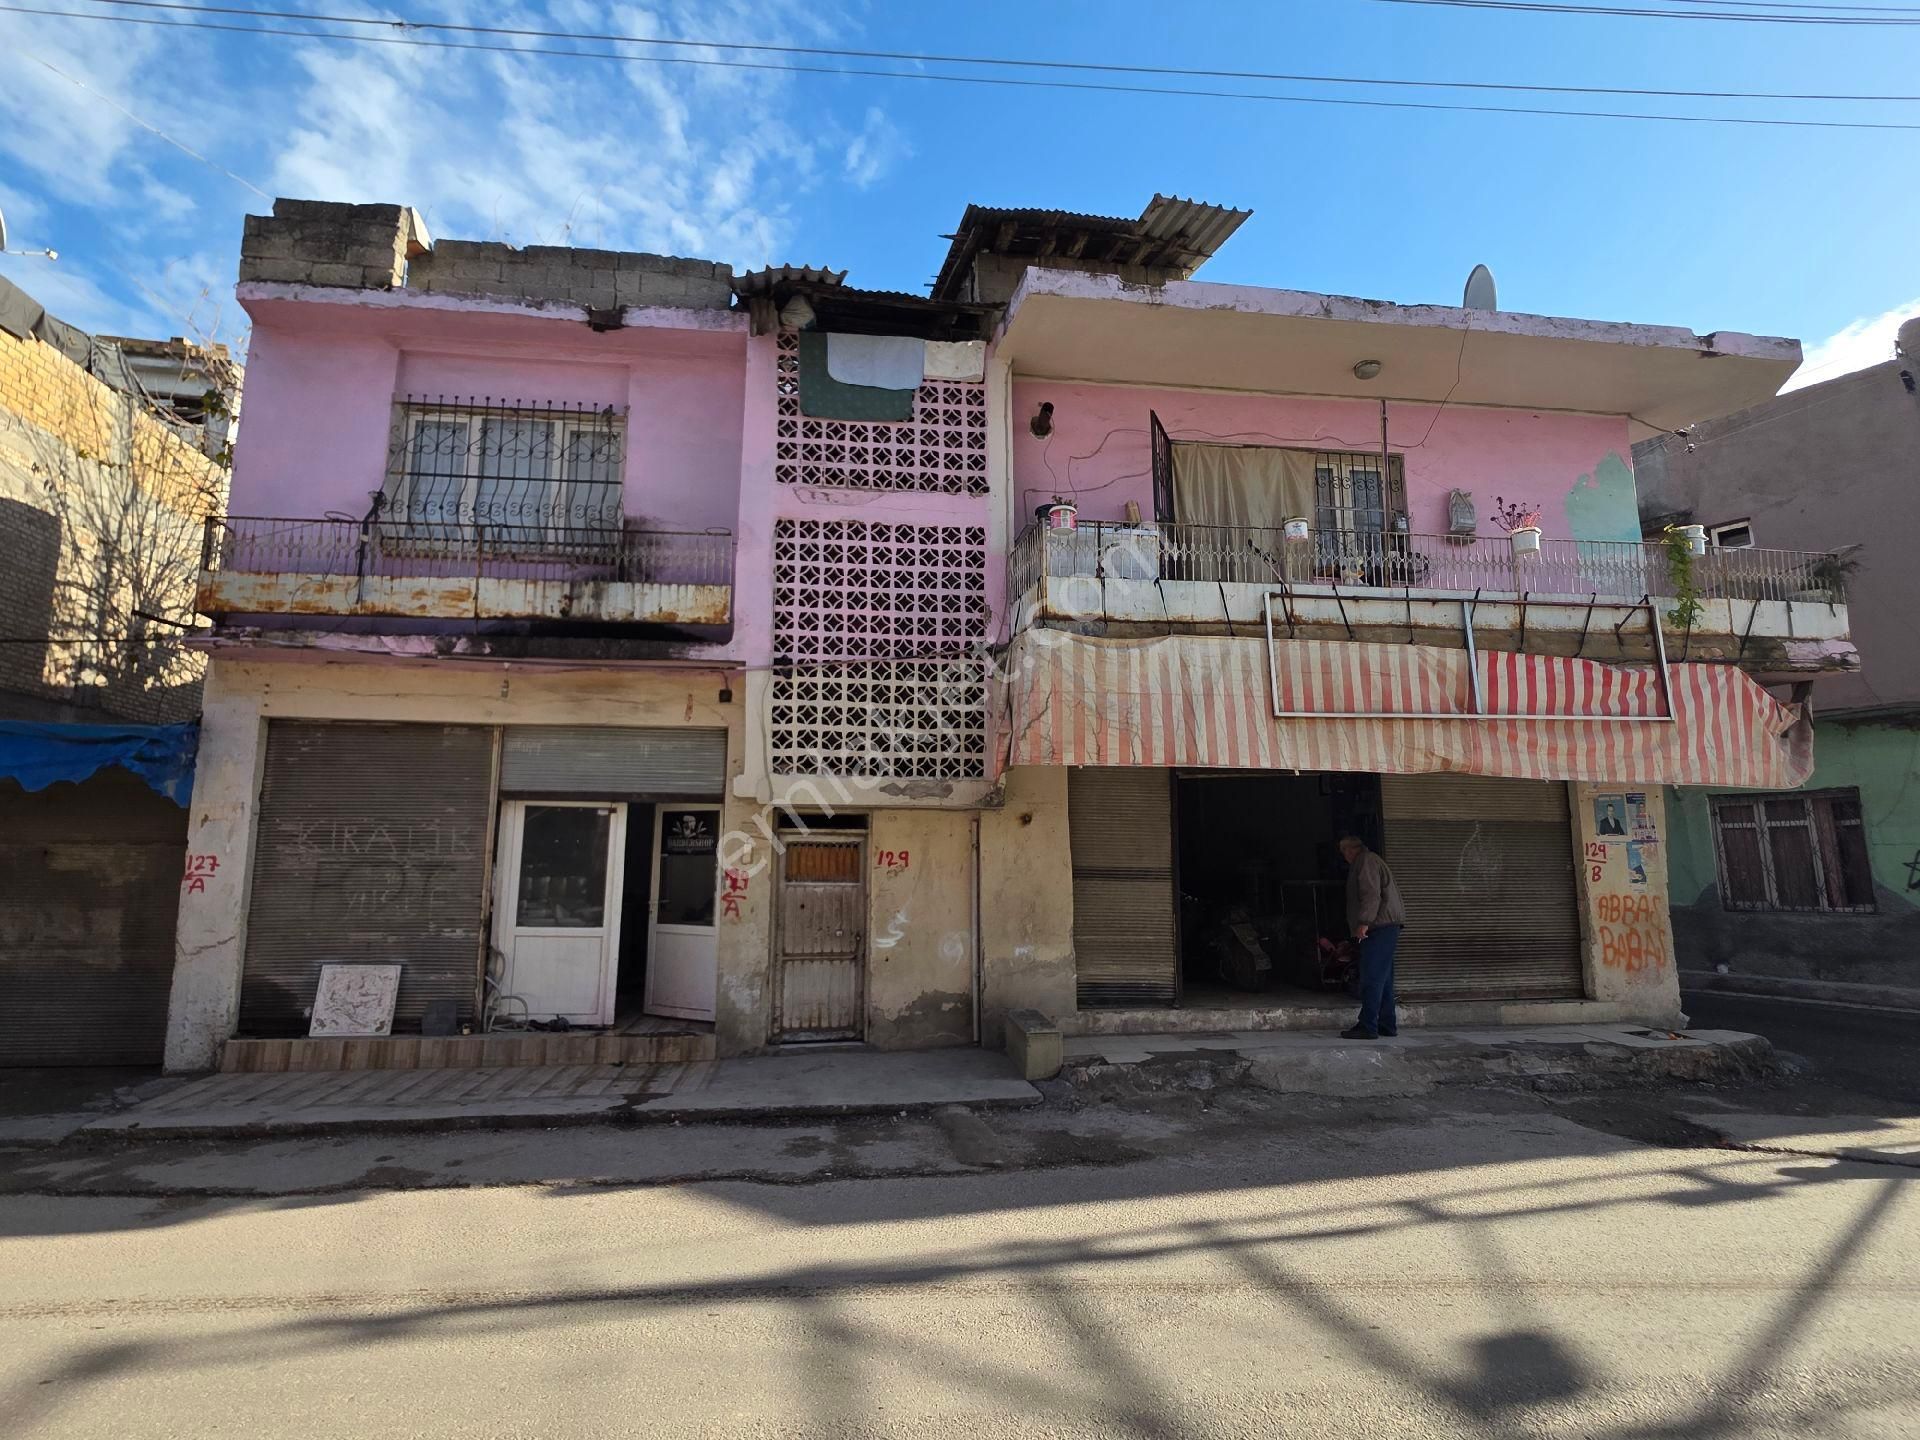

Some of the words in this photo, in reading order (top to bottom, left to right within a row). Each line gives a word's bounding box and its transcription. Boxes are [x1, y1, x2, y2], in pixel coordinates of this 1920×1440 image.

[877, 850, 909, 868] 129
[1584, 842, 1608, 860] 129
[187, 854, 221, 872] 127
[1591, 865, 1603, 882] B
[188, 877, 205, 895] A
[723, 899, 740, 917] A
